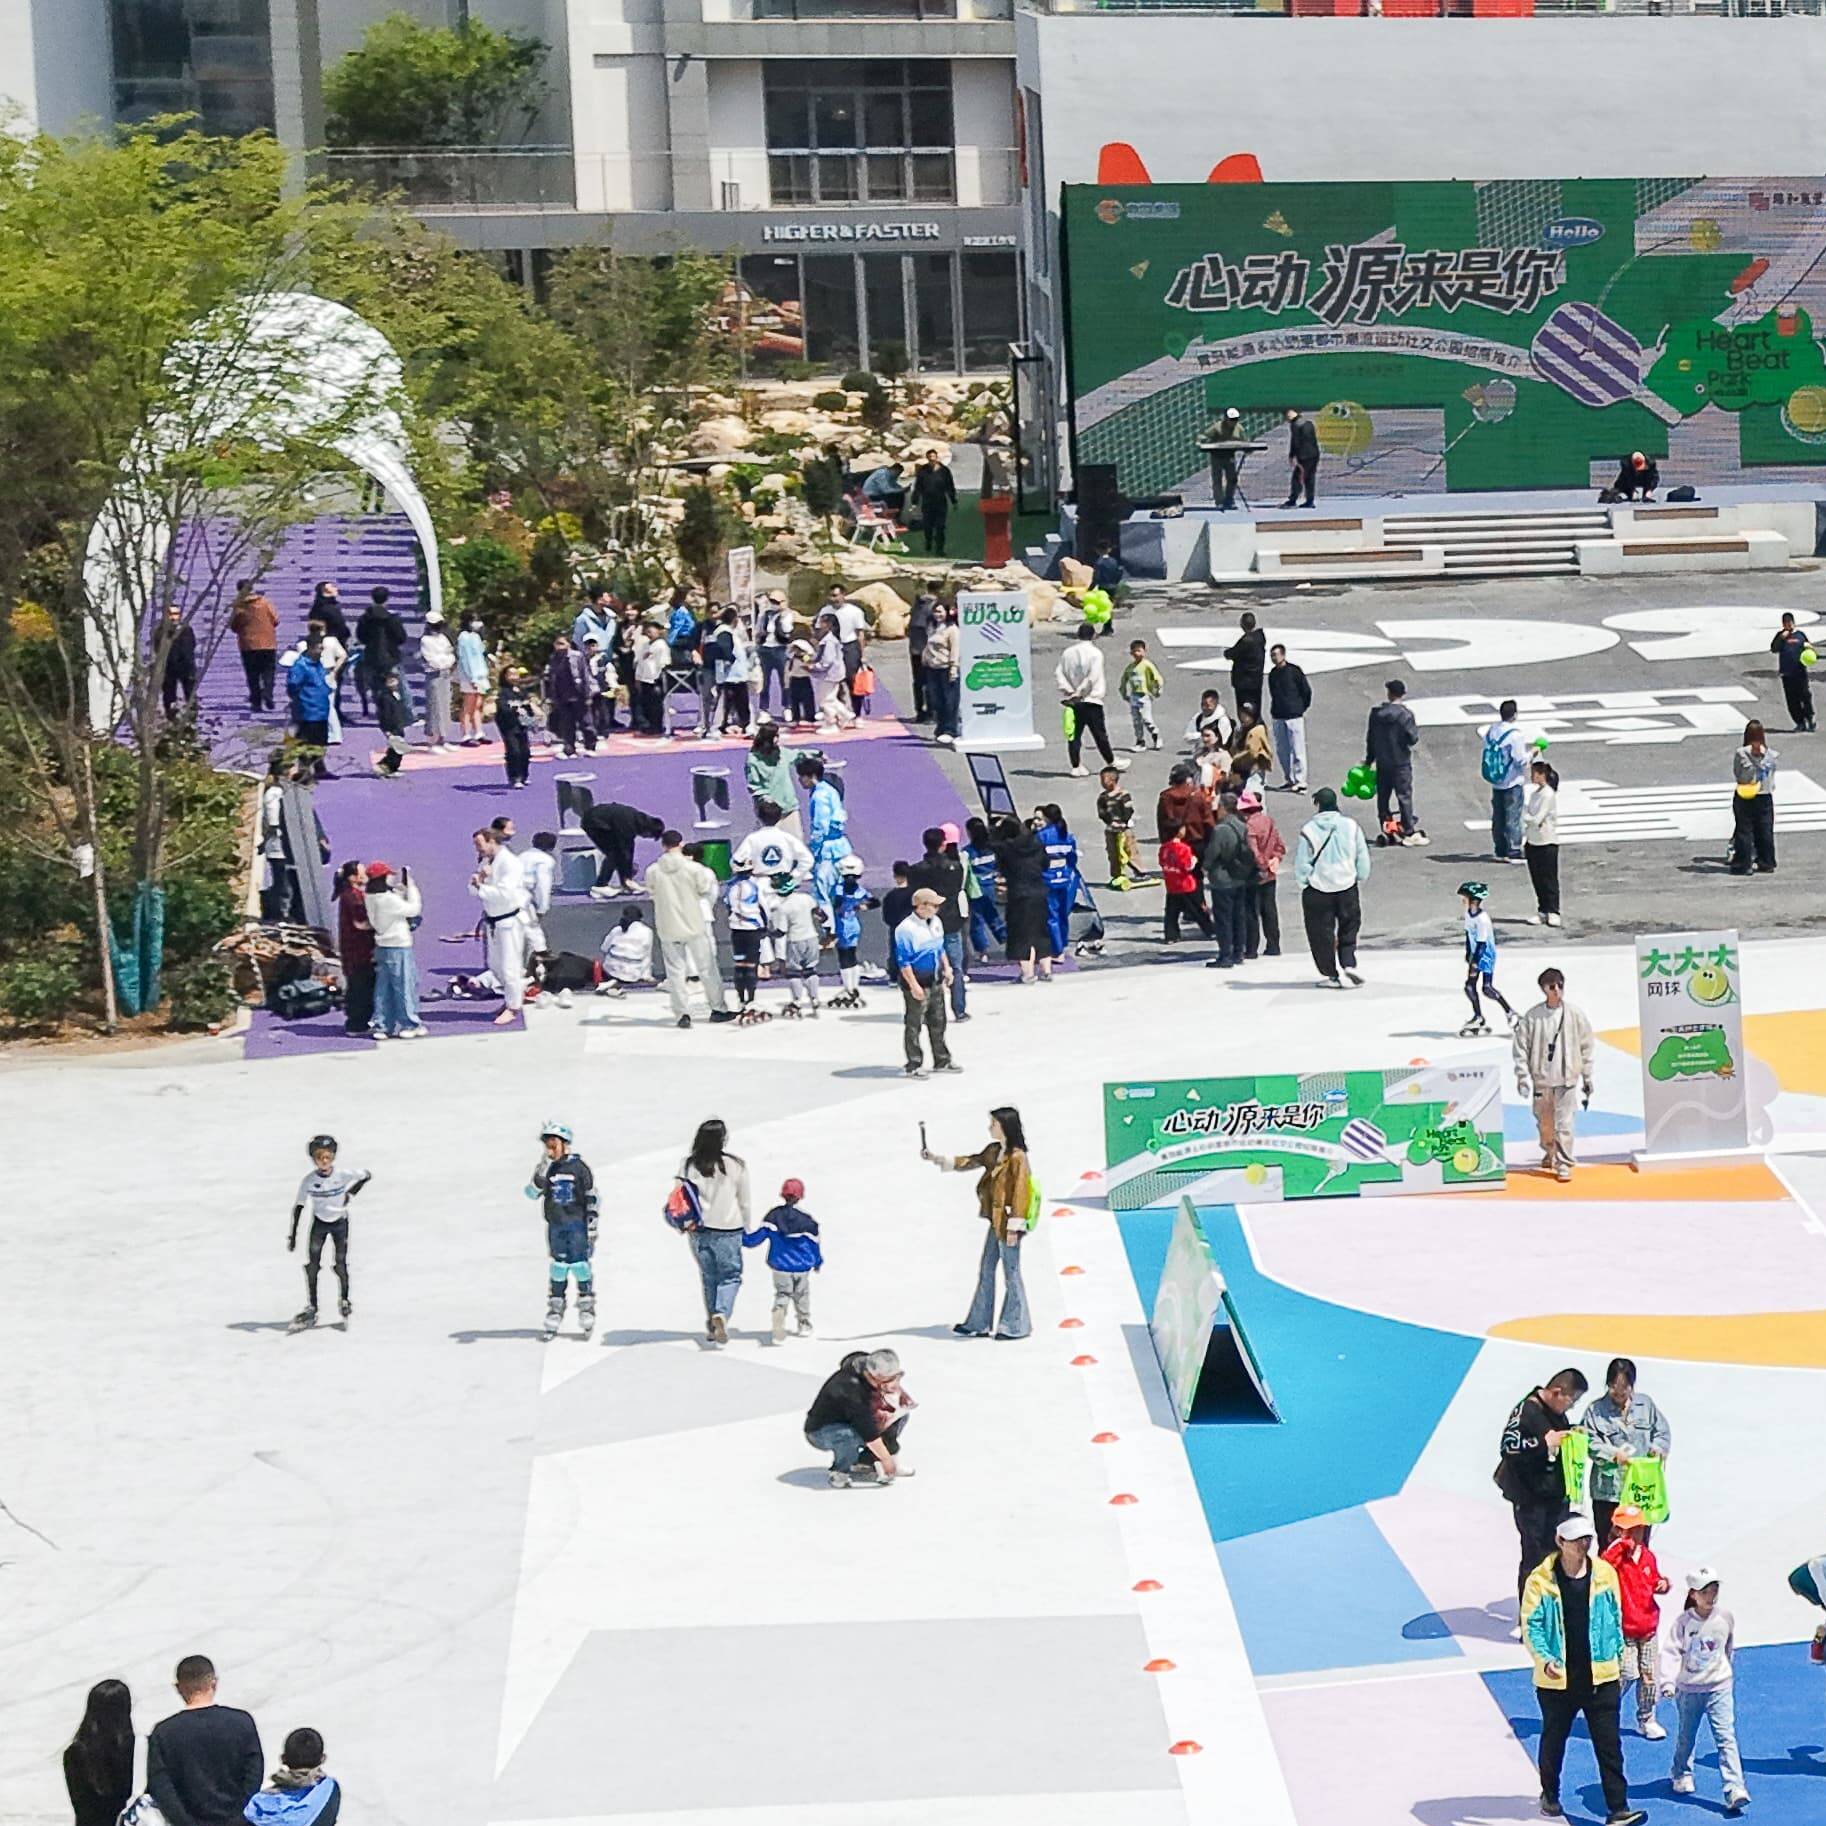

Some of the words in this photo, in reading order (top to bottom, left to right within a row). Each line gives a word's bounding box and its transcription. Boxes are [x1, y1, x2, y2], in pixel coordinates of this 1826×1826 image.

[1550, 224, 1600, 239] Hello
[1166, 245, 1562, 327] 心动源来是你
[1696, 330, 1772, 351] Heart
[1727, 351, 1790, 370] Beat
[1708, 371, 1749, 388] Park
[1647, 982, 1681, 997] 网球
[1162, 1103, 1326, 1135] 心动源来是你
